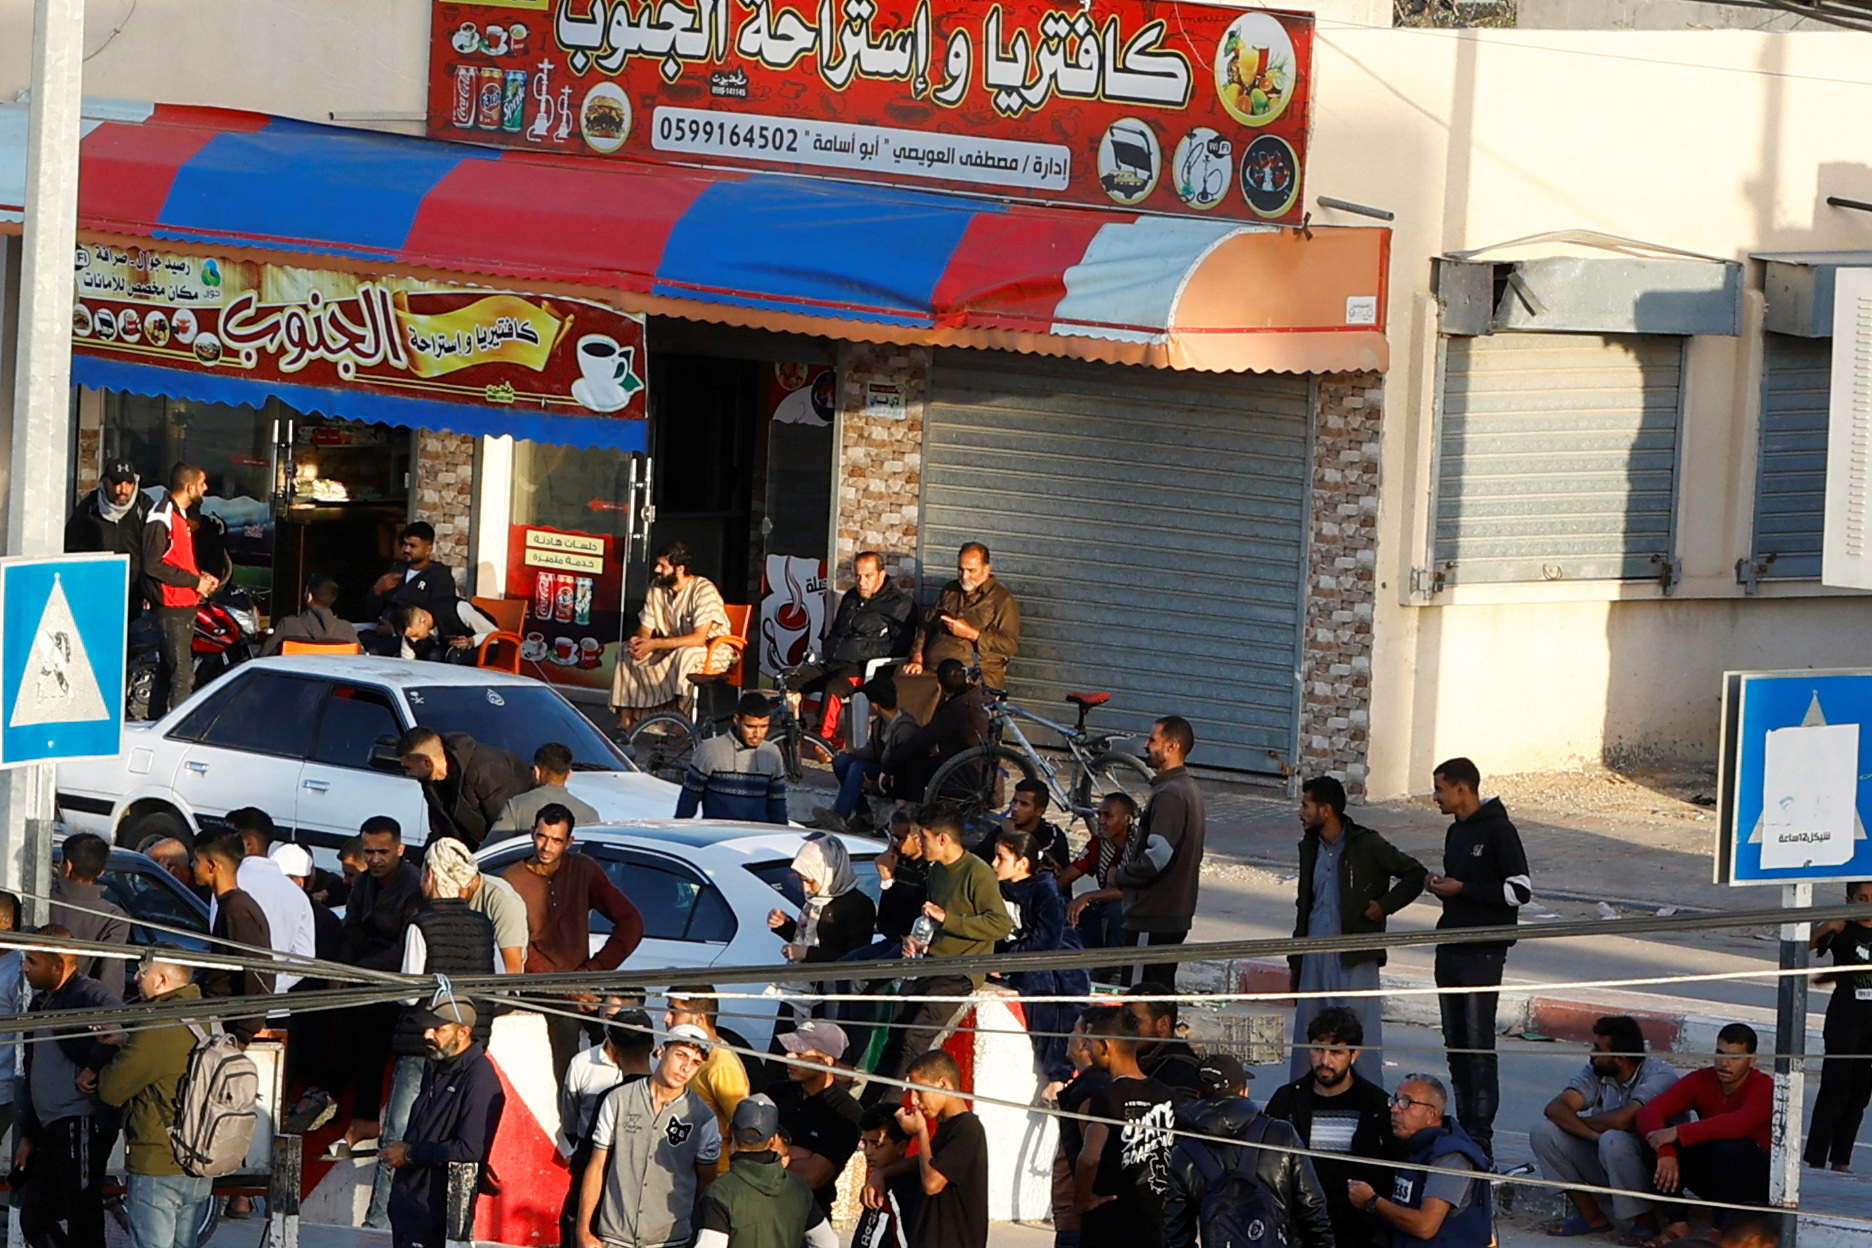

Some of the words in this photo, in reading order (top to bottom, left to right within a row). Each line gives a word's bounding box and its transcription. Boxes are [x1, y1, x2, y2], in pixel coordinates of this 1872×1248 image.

[660, 116, 799, 152] 0599164502
[959, 150, 1019, 171] مصطفى
[1033, 155, 1068, 181] إدارة
[221, 282, 407, 379] الجنوب
